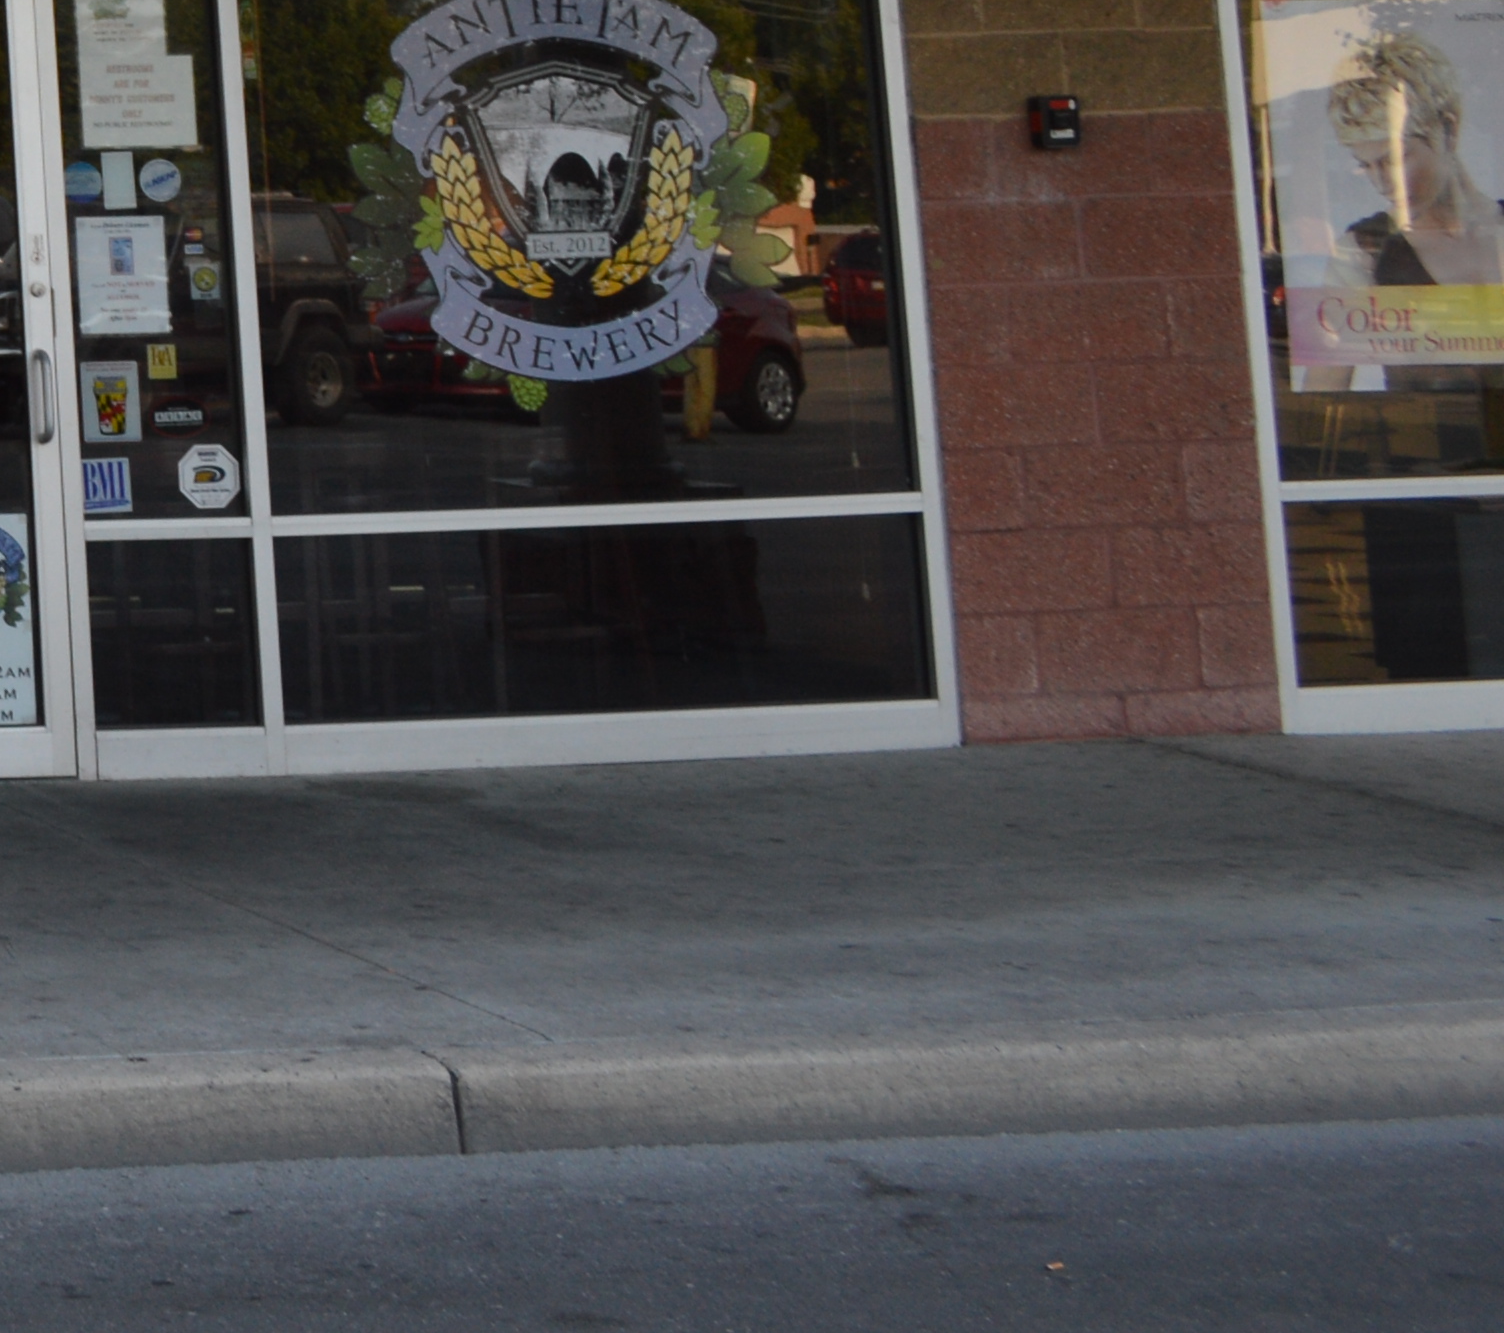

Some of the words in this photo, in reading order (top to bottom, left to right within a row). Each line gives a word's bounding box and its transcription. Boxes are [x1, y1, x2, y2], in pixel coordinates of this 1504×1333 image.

[532, 235, 561, 255] Est.
[567, 235, 607, 254] 2012
[1317, 296, 1419, 334] Color
[463, 299, 680, 372] BREWERY
[1368, 336, 1419, 357] your
[82, 461, 126, 500] BMI
